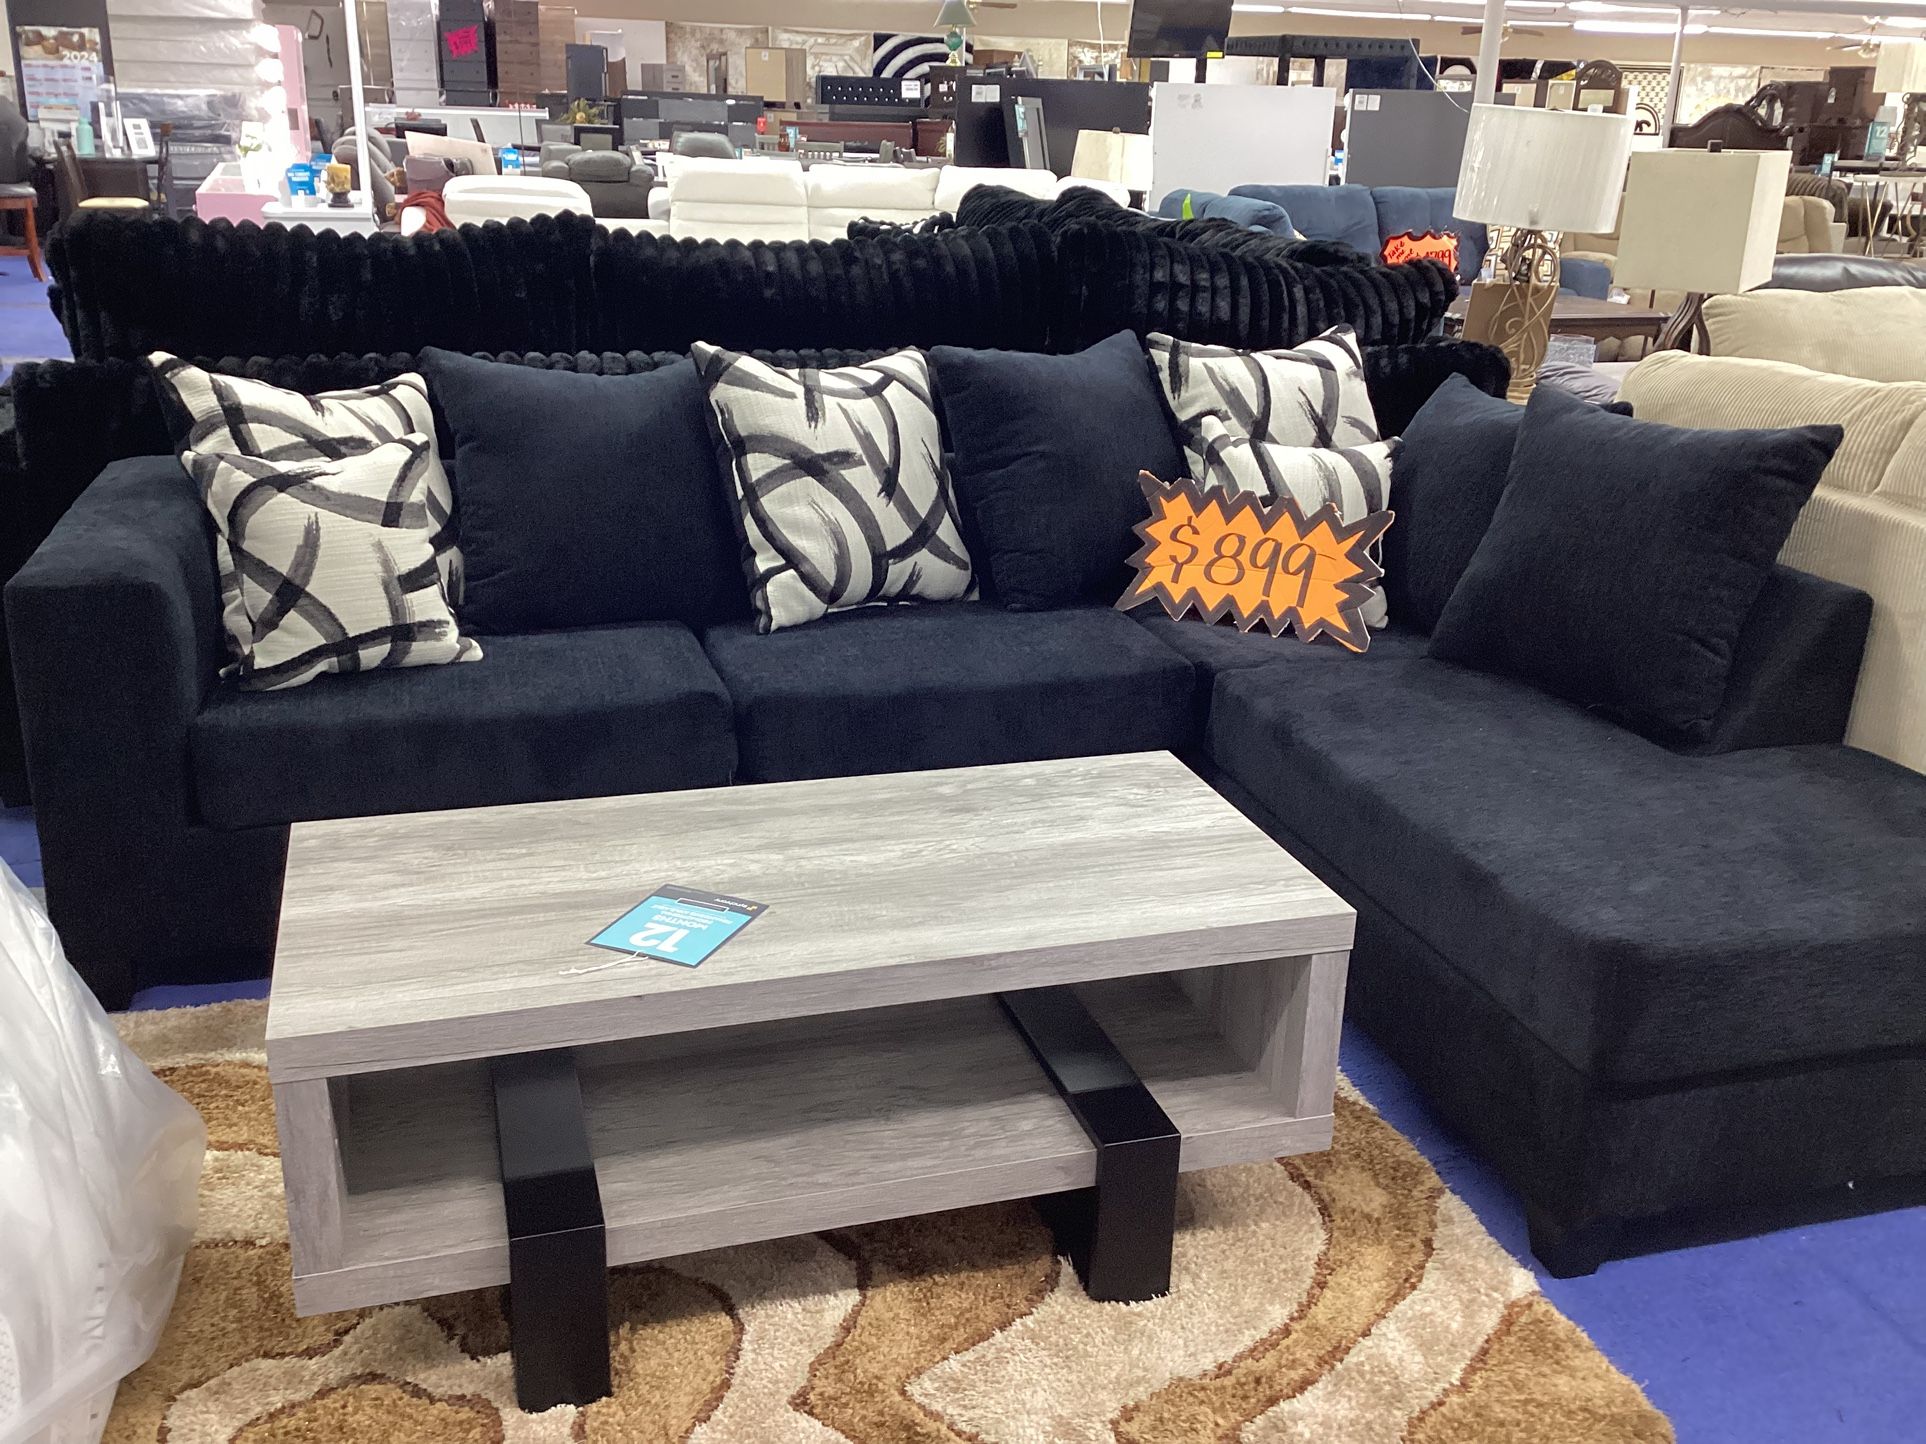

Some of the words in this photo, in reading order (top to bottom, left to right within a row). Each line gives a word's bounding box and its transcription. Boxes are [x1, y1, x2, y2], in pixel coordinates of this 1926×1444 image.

[62, 50, 98, 63] 2024
[1875, 126, 1887, 138] 12
[1168, 515, 1317, 608] $899
[629, 922, 690, 953] 12
